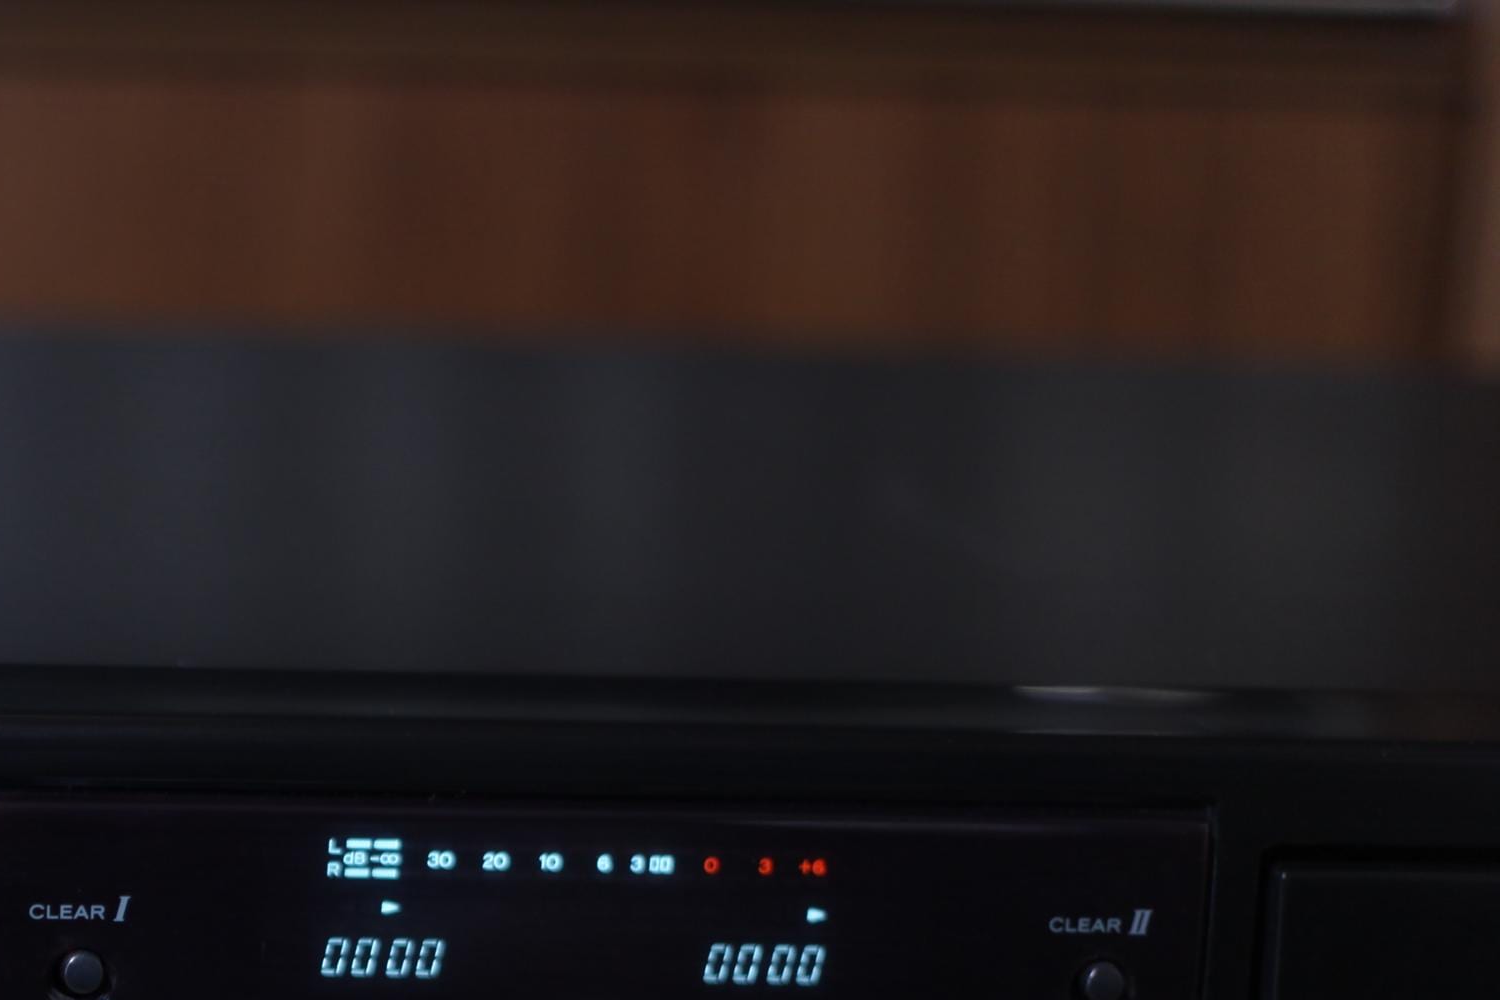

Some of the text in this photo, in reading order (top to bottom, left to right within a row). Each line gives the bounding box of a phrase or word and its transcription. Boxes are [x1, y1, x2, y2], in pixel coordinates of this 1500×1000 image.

[327, 838, 342, 855] L
[326, 861, 343, 878] R
[343, 851, 367, 866] dB
[426, 850, 456, 869] 30
[482, 851, 512, 872] 20
[538, 852, 564, 872] 10
[597, 853, 614, 874] 6
[703, 855, 720, 875] 0
[758, 856, 774, 876] 3
[798, 857, 828, 877] +6
[28, 903, 105, 920] CLEAR
[1048, 916, 1122, 934] CLEAR
[320, 936, 447, 979] 0000
[702, 942, 827, 986] 0000
